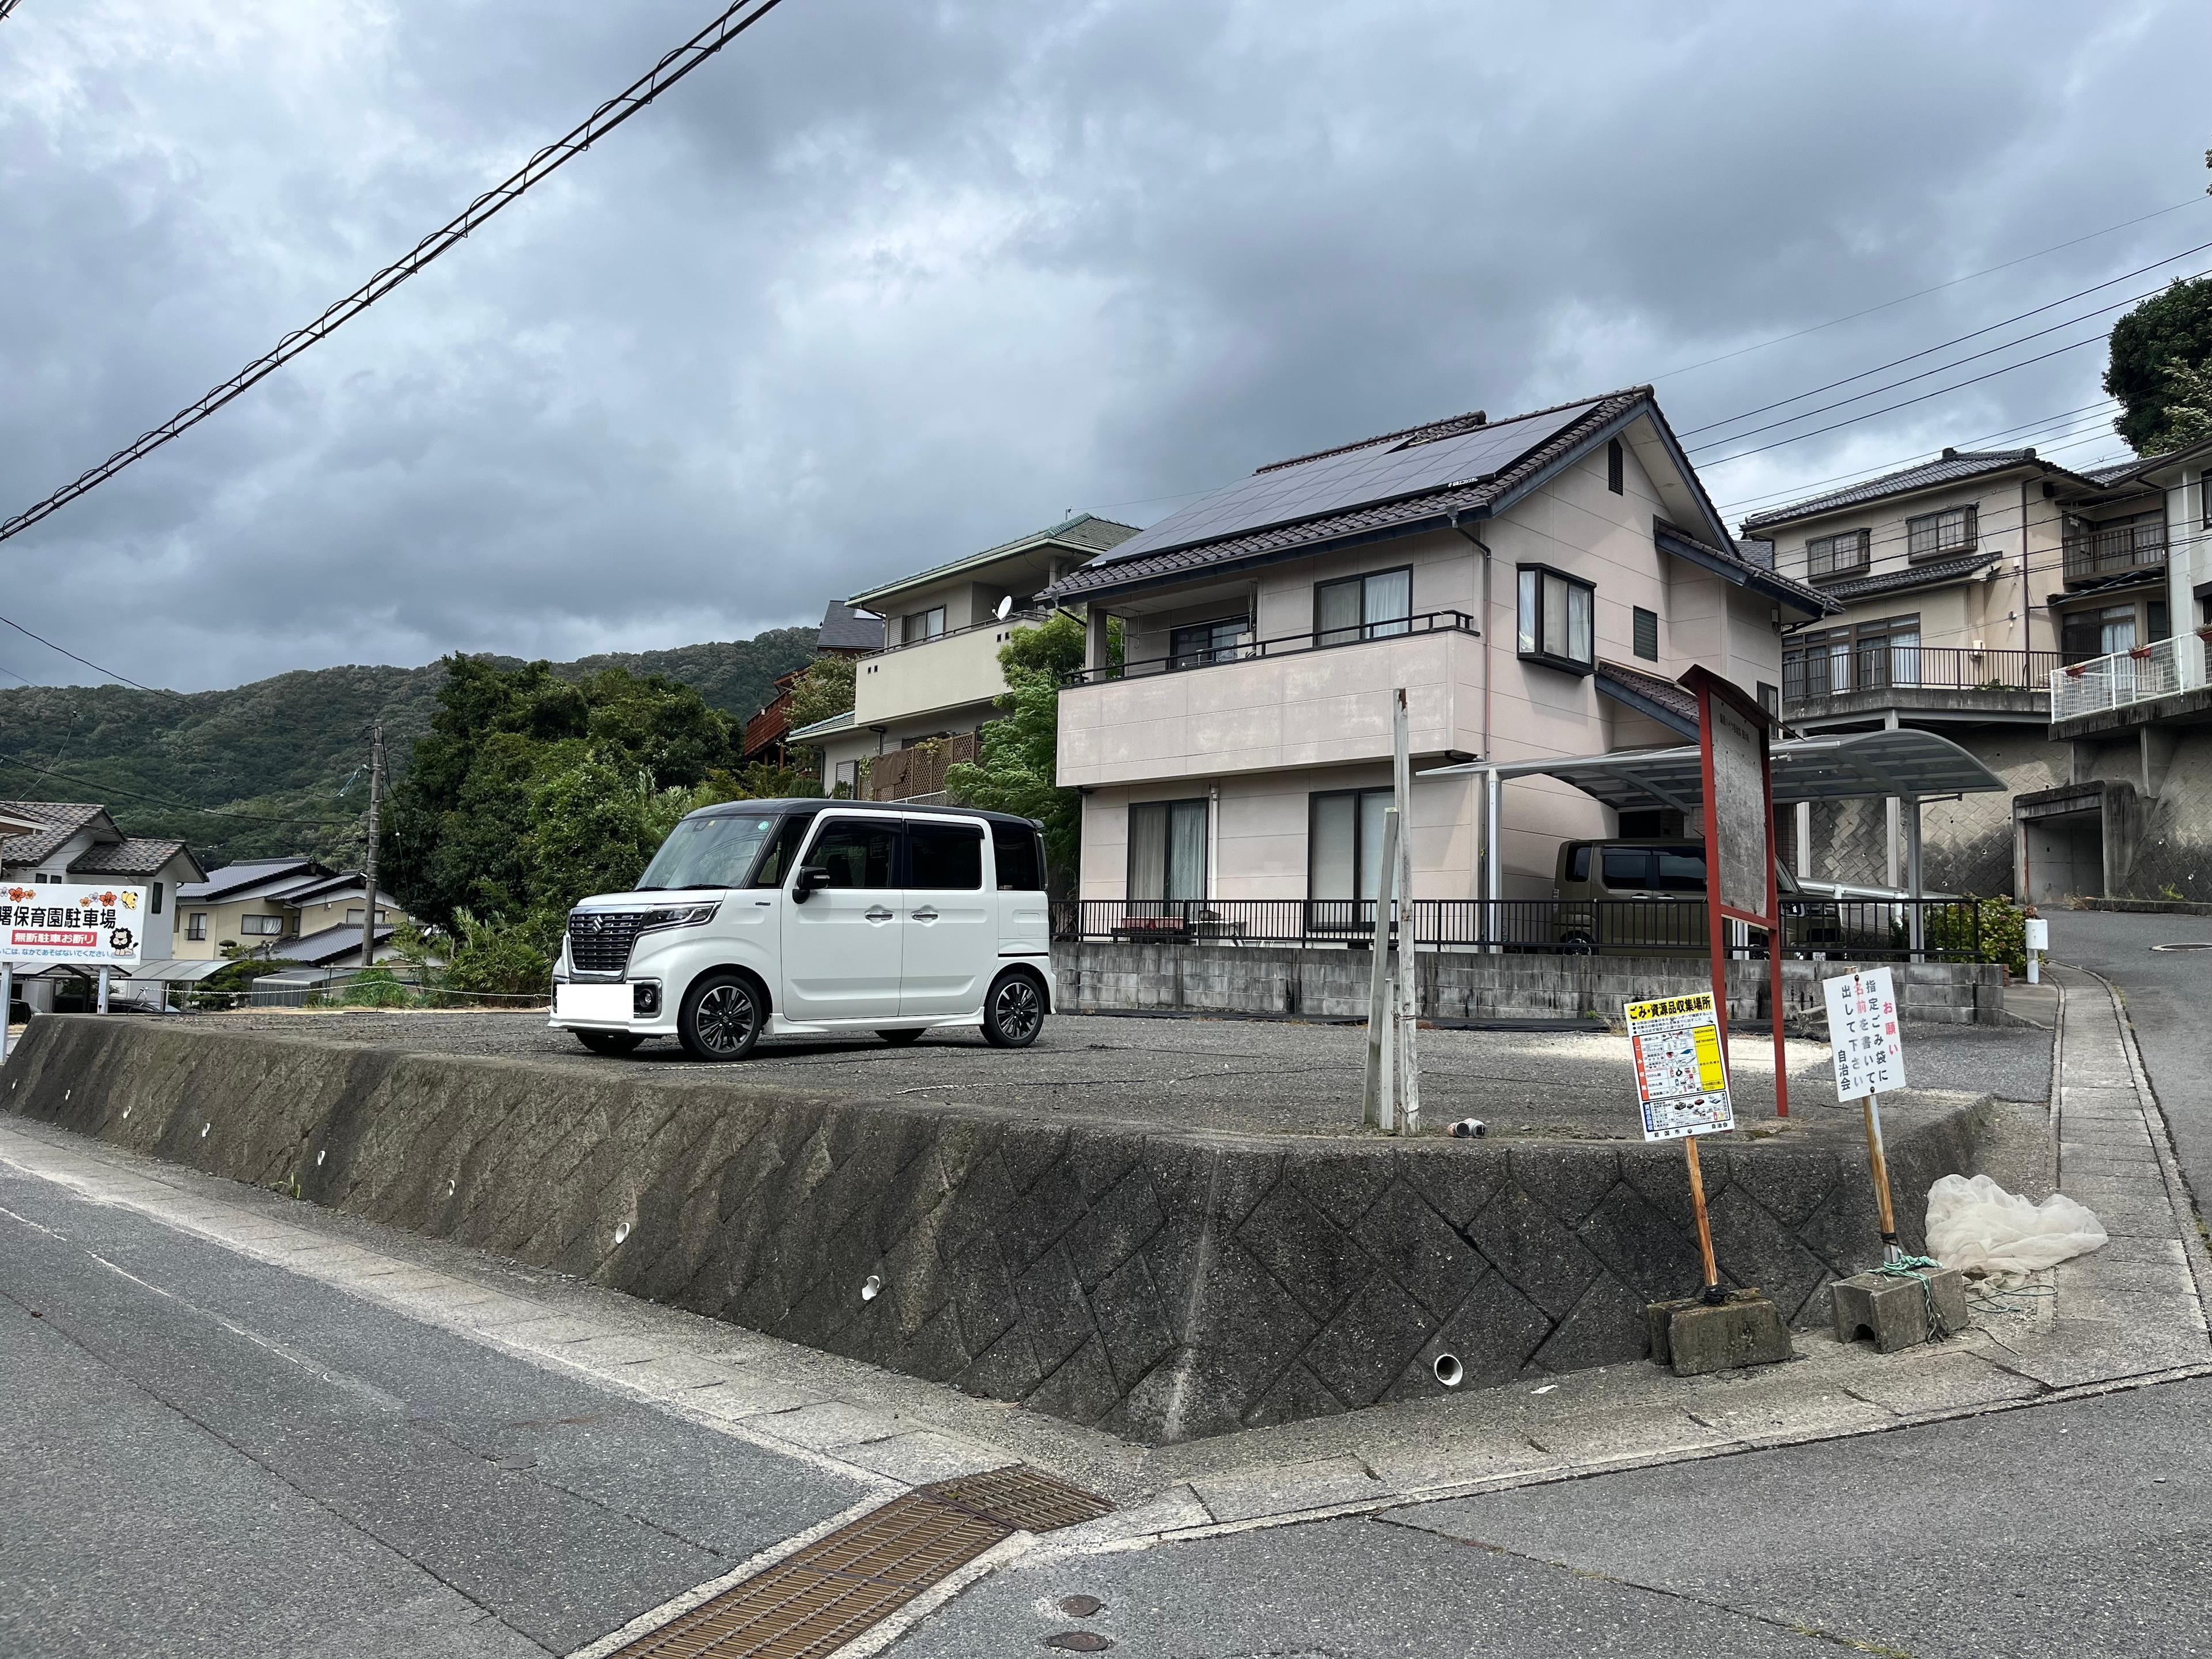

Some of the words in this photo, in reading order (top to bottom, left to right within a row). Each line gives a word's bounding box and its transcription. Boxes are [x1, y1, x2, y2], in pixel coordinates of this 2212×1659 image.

[14, 933, 94, 944] 無断駐車お断り
[1630, 996, 1711, 1020] ごみ・資源品収集場所
[1853, 983, 1875, 1084] 名前を書いて
[1866, 980, 1888, 1081] 指定ごみ袋に
[1883, 1002, 1898, 1055] お願い
[1842, 985, 1863, 1087] 出して下さい
[1838, 1050, 1851, 1090] 自治会
